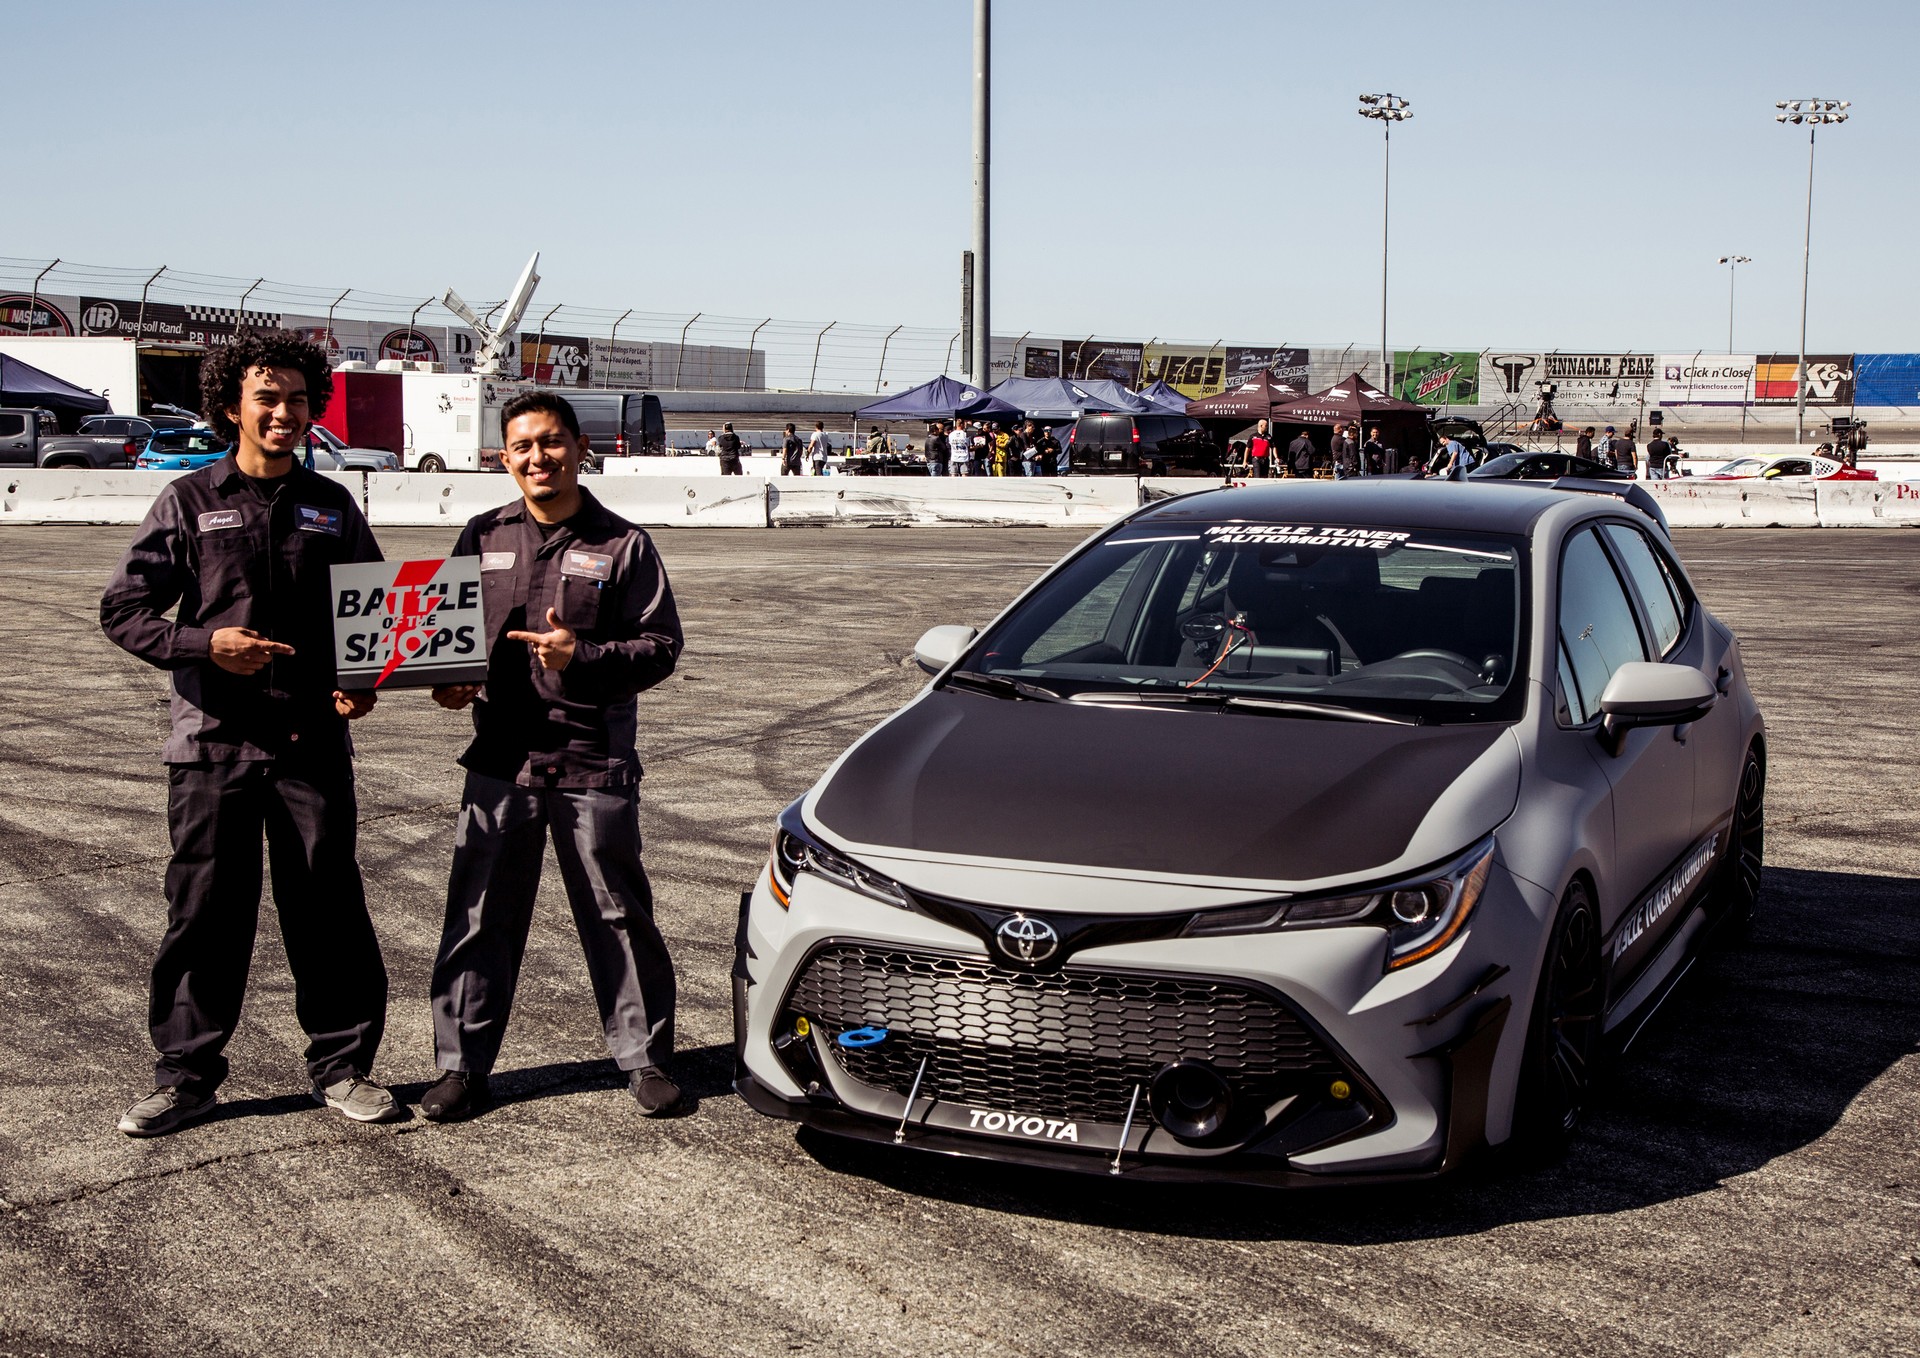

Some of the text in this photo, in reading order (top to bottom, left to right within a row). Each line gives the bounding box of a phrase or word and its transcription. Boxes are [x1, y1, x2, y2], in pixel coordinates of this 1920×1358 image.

[88, 306, 114, 329] IR
[400, 338, 424, 350] NSCAR
[608, 346, 628, 355] Bildings
[1146, 356, 1225, 385] JEGS
[1544, 357, 1655, 376] PINNACLE PEAK
[1683, 367, 1708, 378] Cick
[1722, 367, 1750, 378] Close
[1555, 380, 1652, 388] TEAKHOUSE
[208, 515, 234, 525] Angel
[1204, 525, 1411, 542] MUSCLE TUNER
[1209, 534, 1393, 549] AUTOMOTIVE
[336, 580, 480, 619] BATTLE
[382, 614, 437, 629] OF THE
[344, 626, 476, 663] SHOPS
[1645, 878, 1672, 928] TUNER
[1671, 832, 1719, 901] AUTOMOTIVE
[969, 1109, 1078, 1143] TOYOTA
